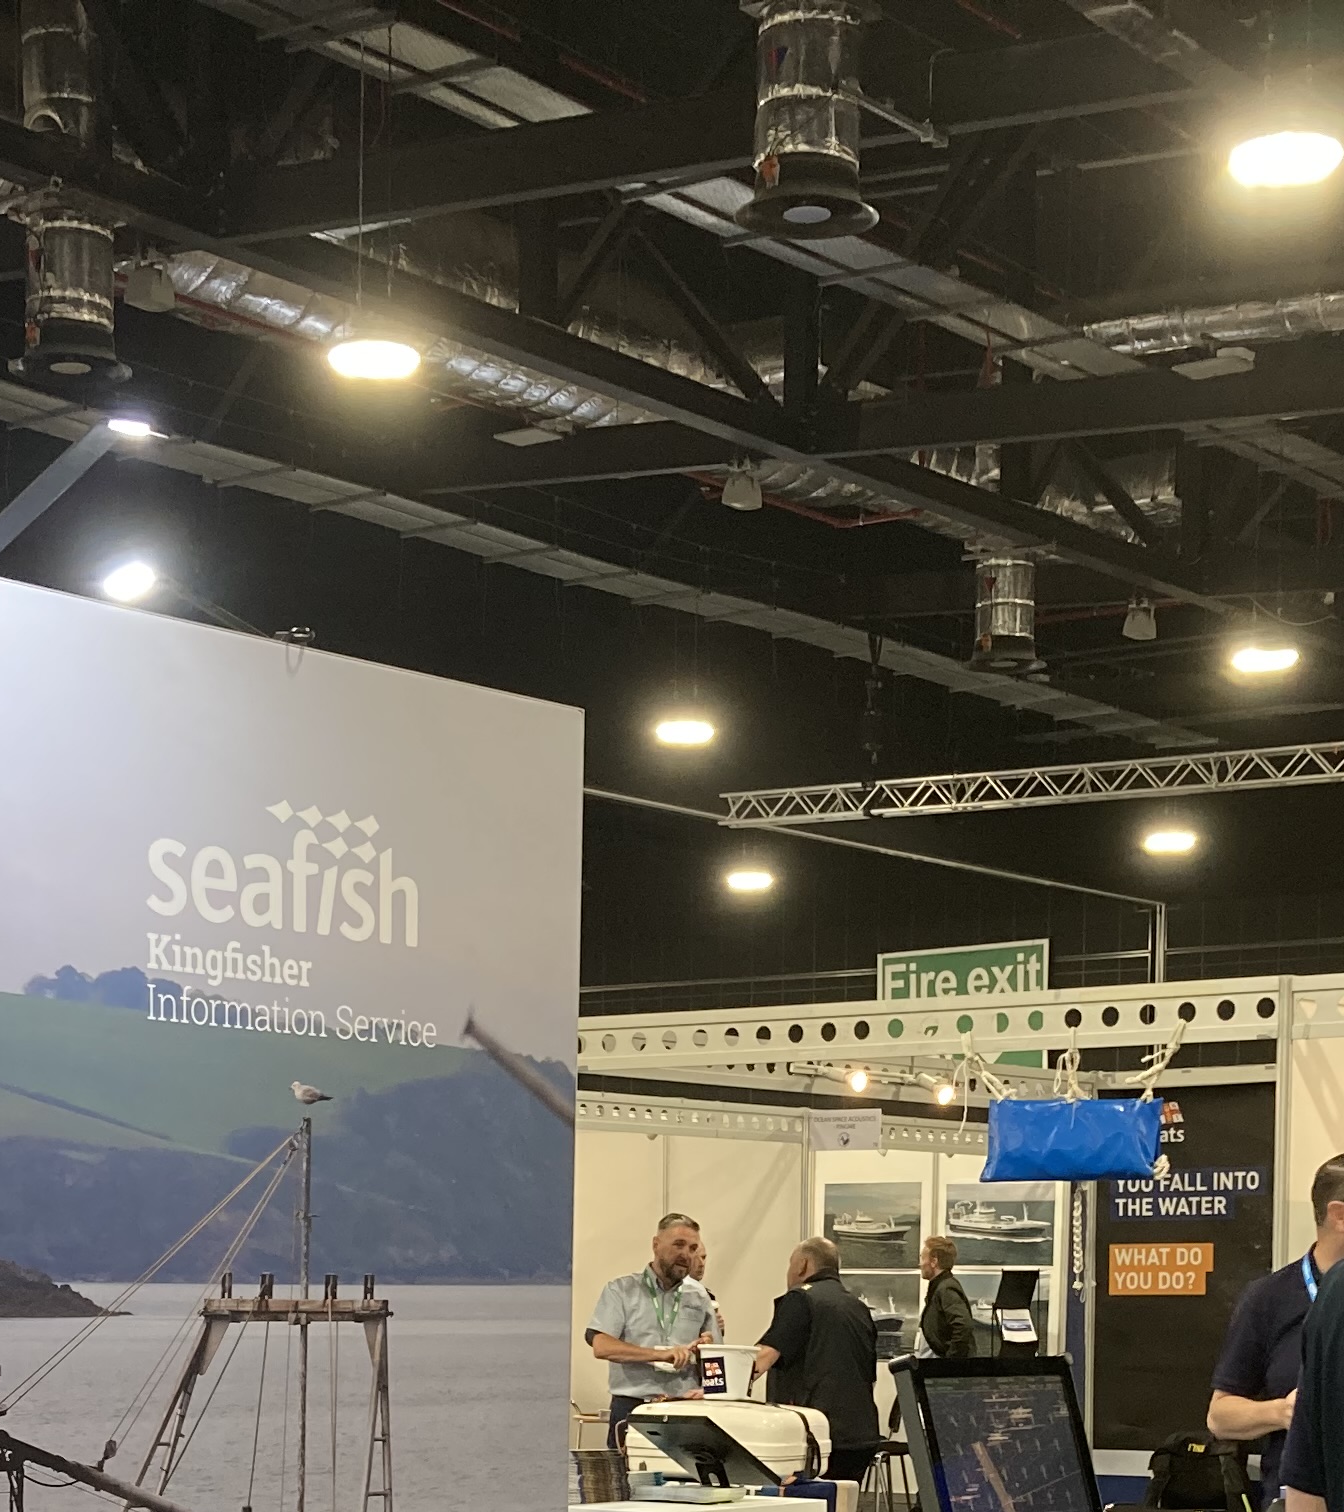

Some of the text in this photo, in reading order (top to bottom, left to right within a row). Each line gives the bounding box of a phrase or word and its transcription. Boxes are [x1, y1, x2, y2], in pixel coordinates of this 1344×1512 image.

[145, 828, 419, 948] seafish
[146, 932, 312, 987] Kingfisher
[885, 953, 1041, 1000] Fire exit
[146, 984, 437, 1048] Information Service
[1160, 1127, 1185, 1143] ats
[1117, 1171, 1259, 1193] YOU FALL INTO
[1115, 1196, 1227, 1217] THE WATER
[1114, 1248, 1202, 1266] WHAT DO
[1114, 1272, 1196, 1290] YOU DO?
